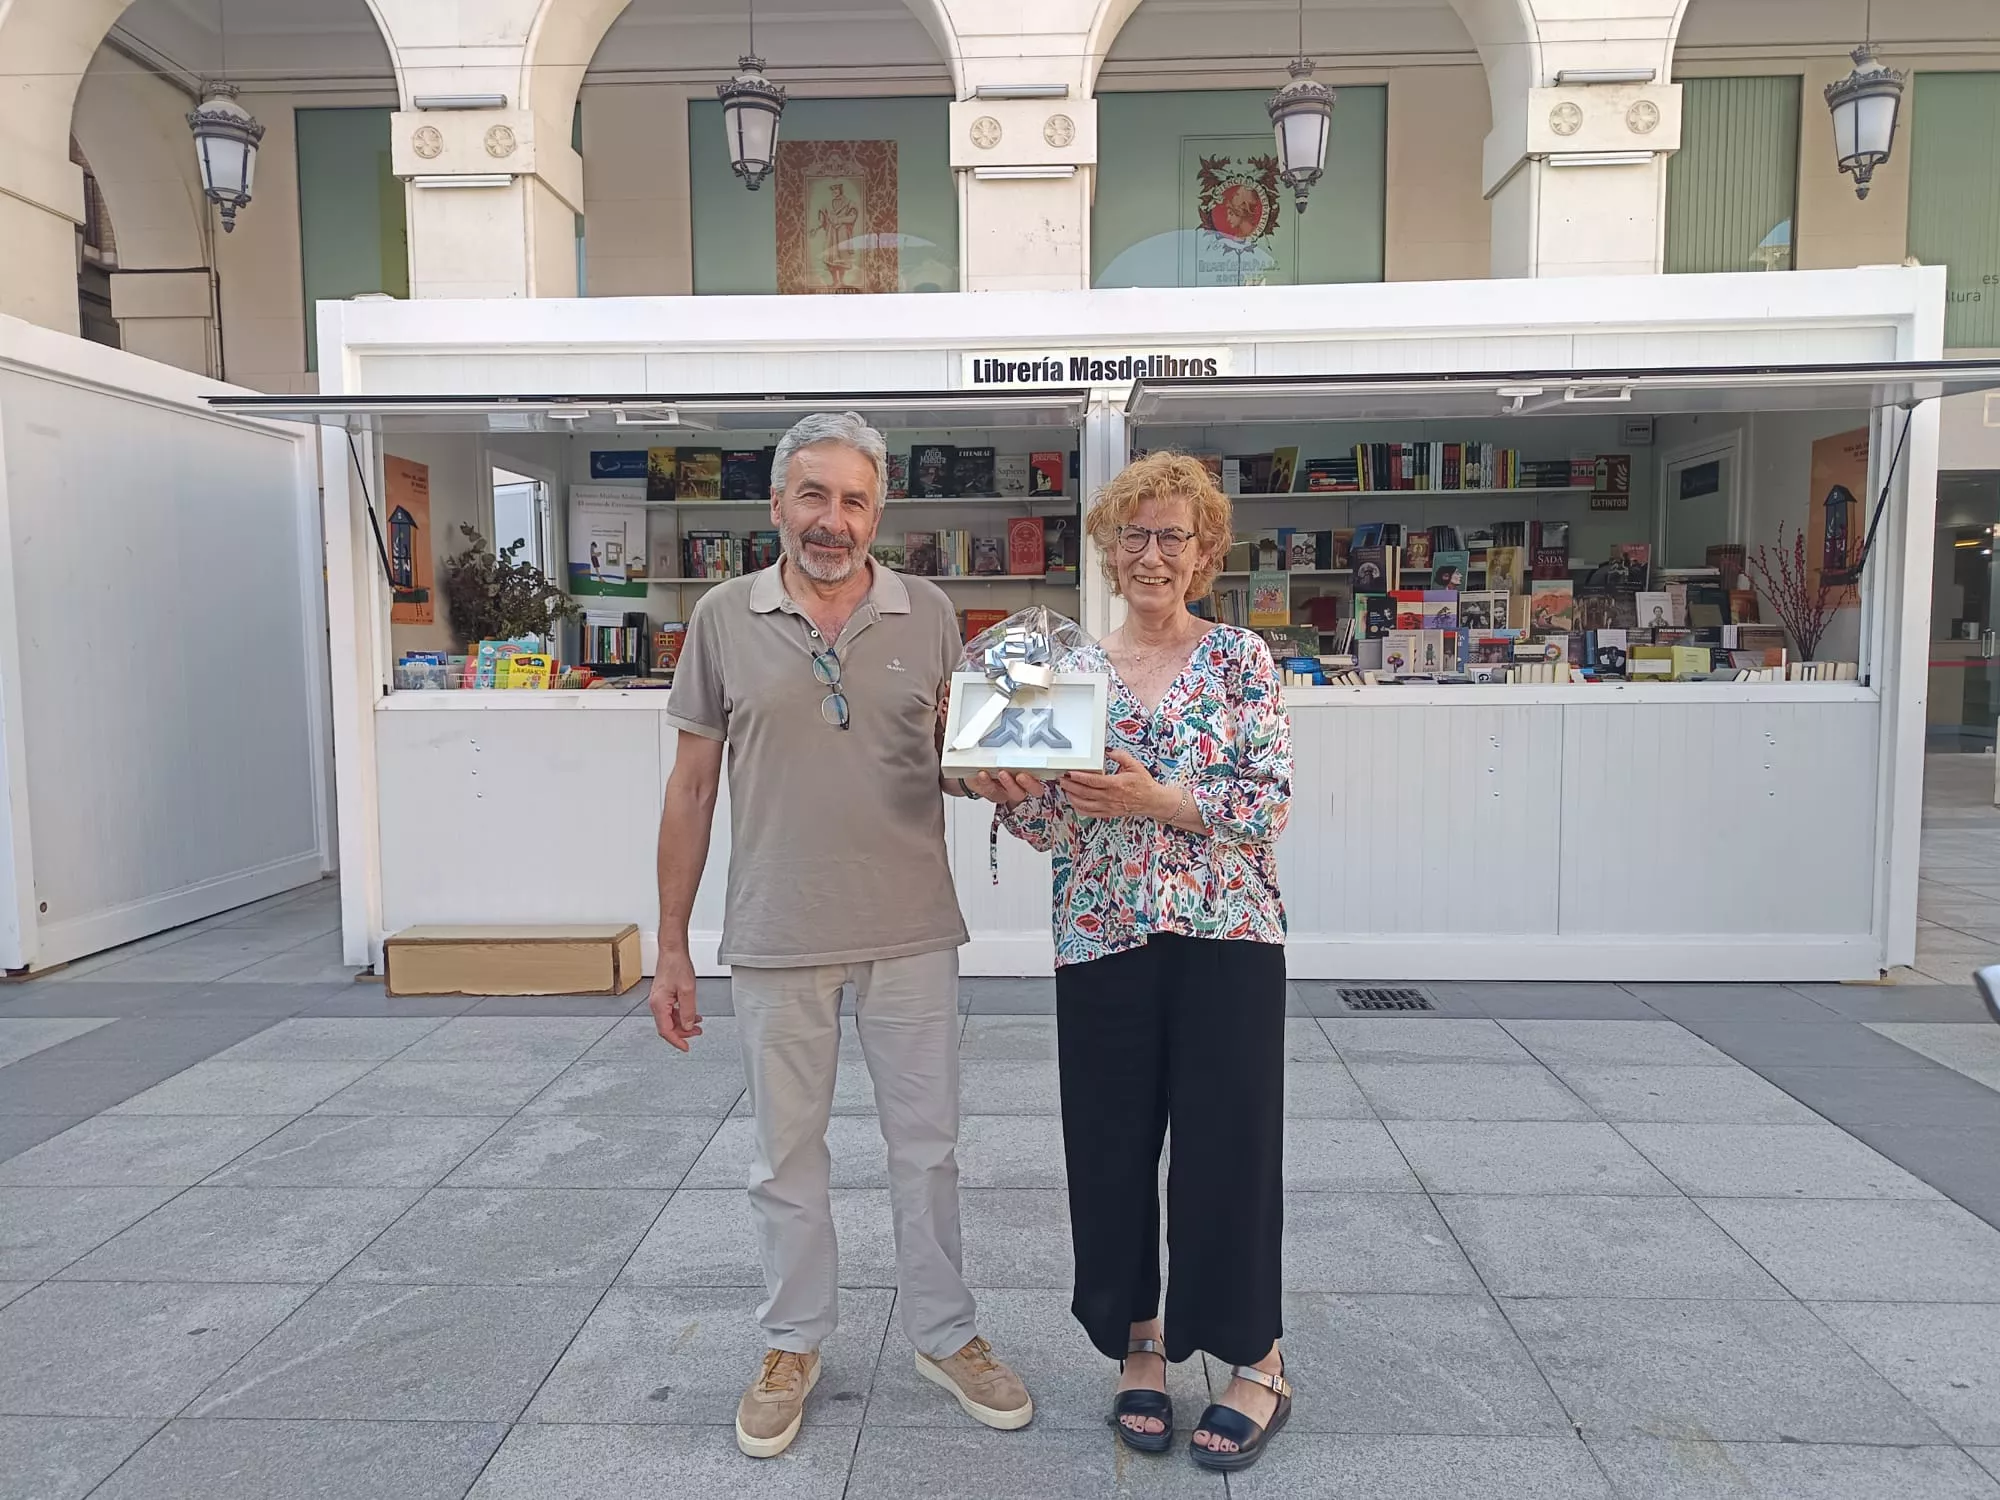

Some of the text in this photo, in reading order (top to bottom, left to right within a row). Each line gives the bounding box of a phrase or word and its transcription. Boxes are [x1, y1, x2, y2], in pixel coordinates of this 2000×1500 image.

[973, 354, 1217, 383] Librería Masdelibros
[1592, 499, 1627, 508] EXTINTOR
[1537, 555, 1563, 564] SADA
